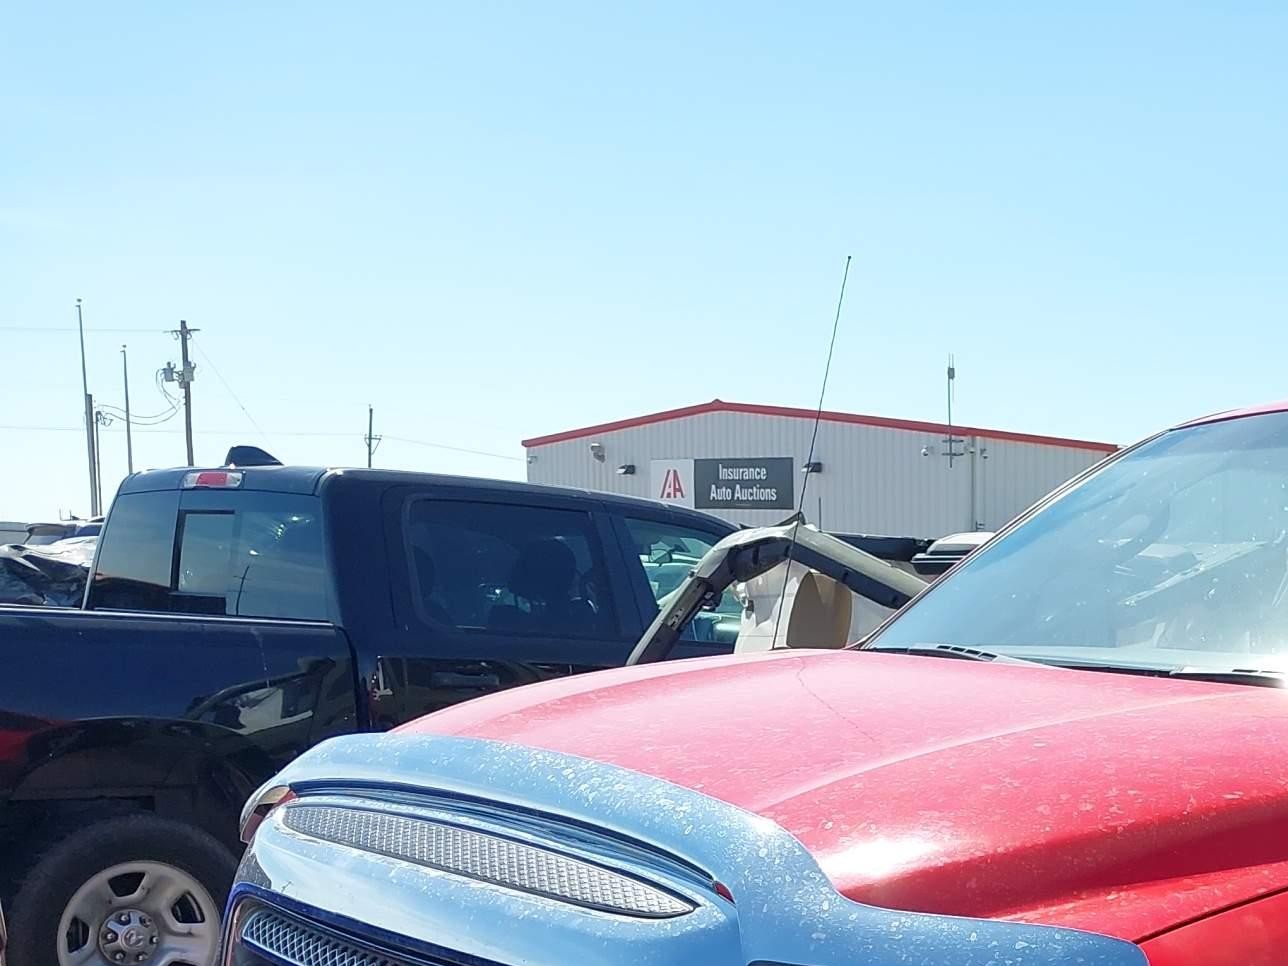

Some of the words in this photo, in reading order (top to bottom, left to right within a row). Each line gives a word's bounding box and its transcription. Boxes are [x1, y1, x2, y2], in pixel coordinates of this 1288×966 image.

[718, 463, 768, 480] Insurance
[709, 484, 732, 501] Auto
[733, 484, 777, 501] Auctions
